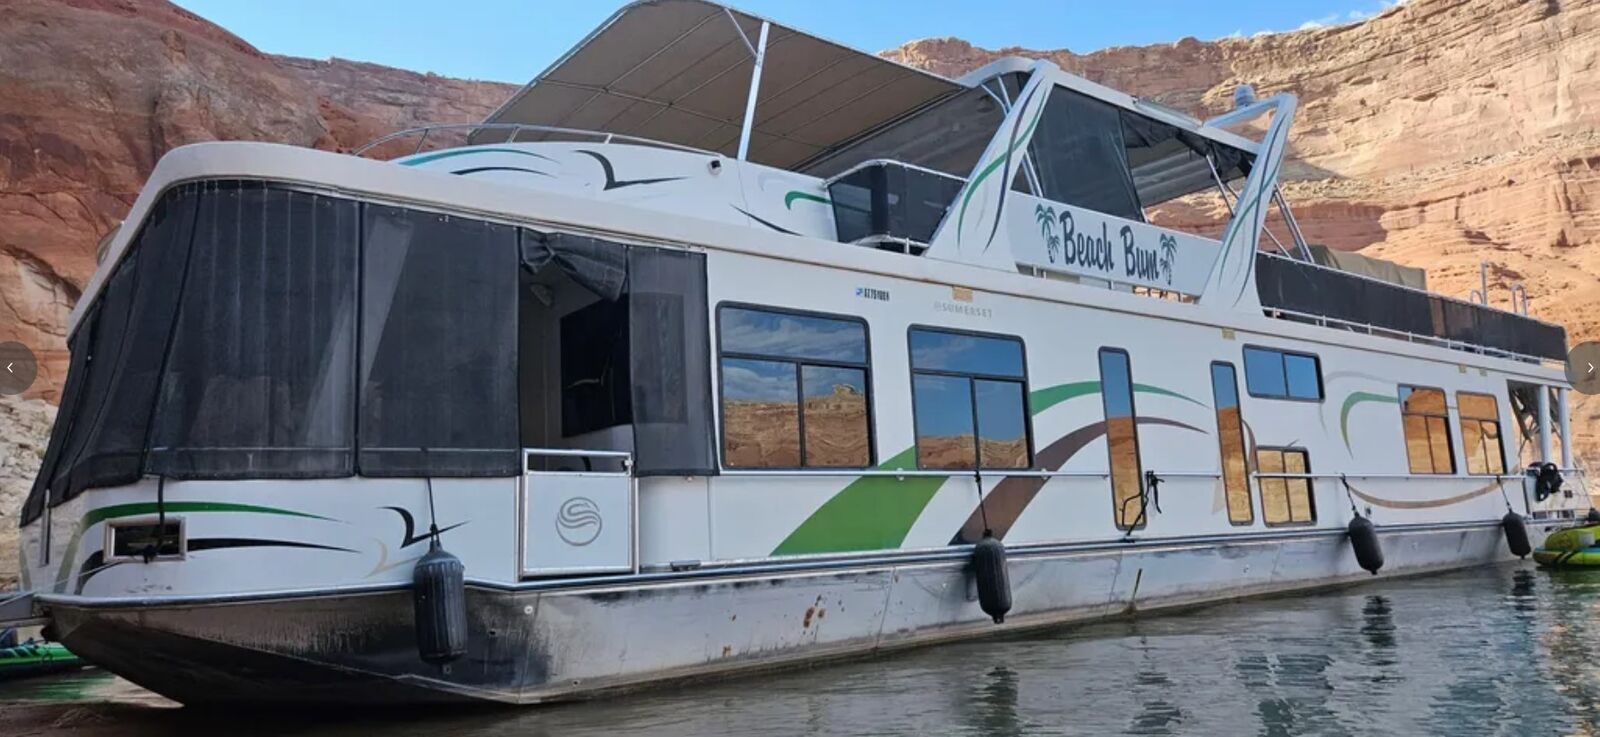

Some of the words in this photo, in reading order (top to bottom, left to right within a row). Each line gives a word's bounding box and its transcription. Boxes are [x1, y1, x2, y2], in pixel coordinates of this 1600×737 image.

[1059, 210, 1114, 273] Beach
[1120, 224, 1160, 281] Bum
[942, 302, 993, 319] SOMERSET
